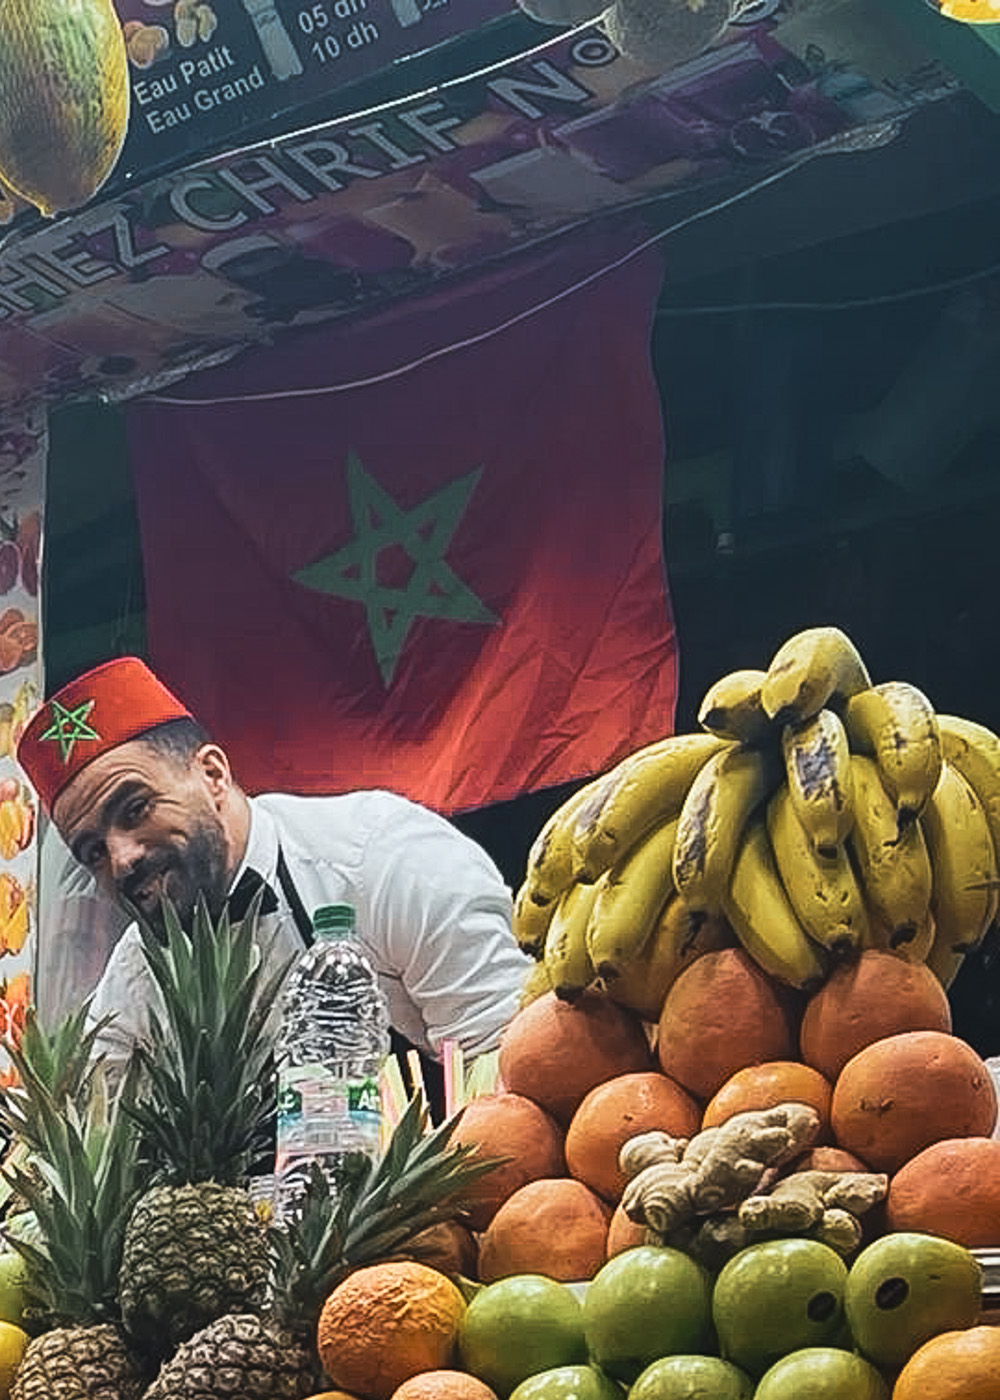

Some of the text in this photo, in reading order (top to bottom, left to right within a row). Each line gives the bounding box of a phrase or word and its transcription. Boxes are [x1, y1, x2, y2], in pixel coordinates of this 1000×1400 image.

[299, 8, 329, 35] 05
[312, 22, 380, 64] 10 dh
[133, 73, 177, 105] Eau
[146, 66, 265, 134] Eau Grand
[168, 100, 462, 235] CHRIF
